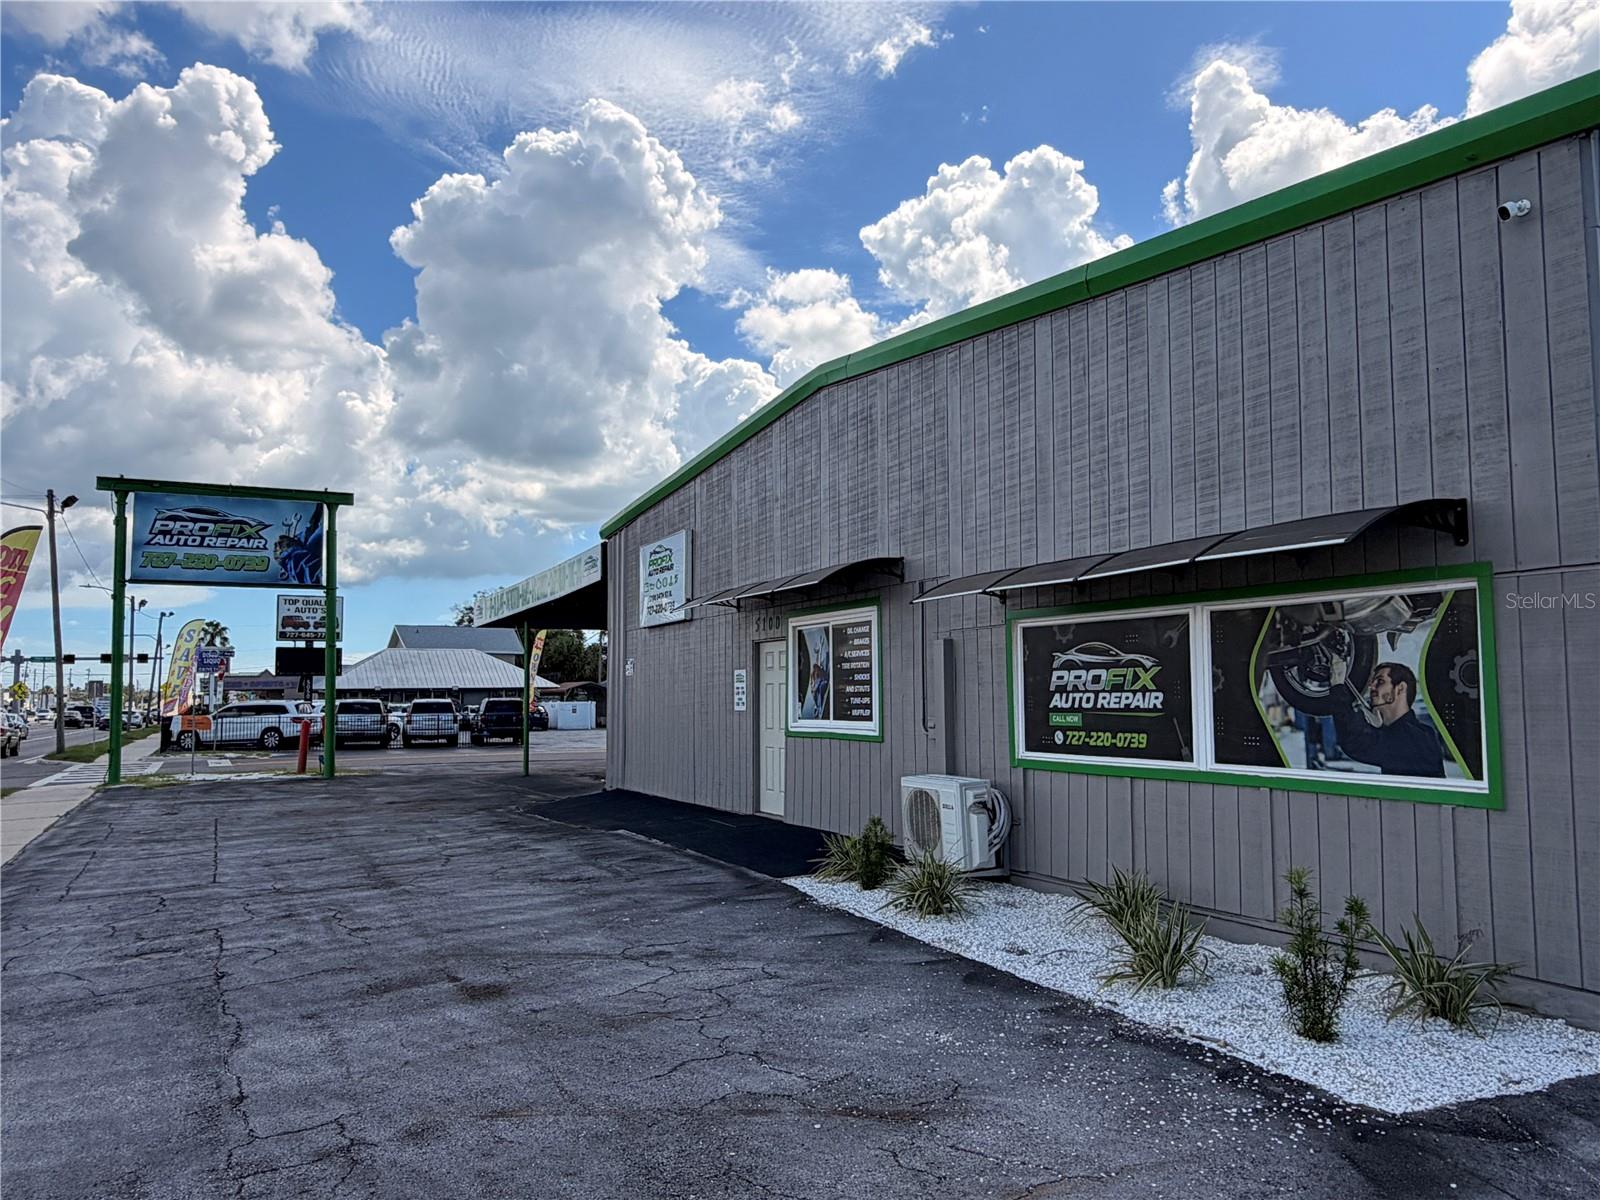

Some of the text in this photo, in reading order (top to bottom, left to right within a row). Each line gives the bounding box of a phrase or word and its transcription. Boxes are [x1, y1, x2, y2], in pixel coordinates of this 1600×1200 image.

[152, 520, 266, 538] PROFIX
[150, 535, 267, 549] AUTO REPAIR
[140, 551, 270, 572] 727-220-0739
[302, 599, 327, 607] QUALI
[755, 615, 780, 632] 5100
[1049, 666, 1162, 691] PROFIX
[1049, 691, 1163, 709] AUTO REPAIR
[1066, 731, 1147, 748] 727-220-0739
